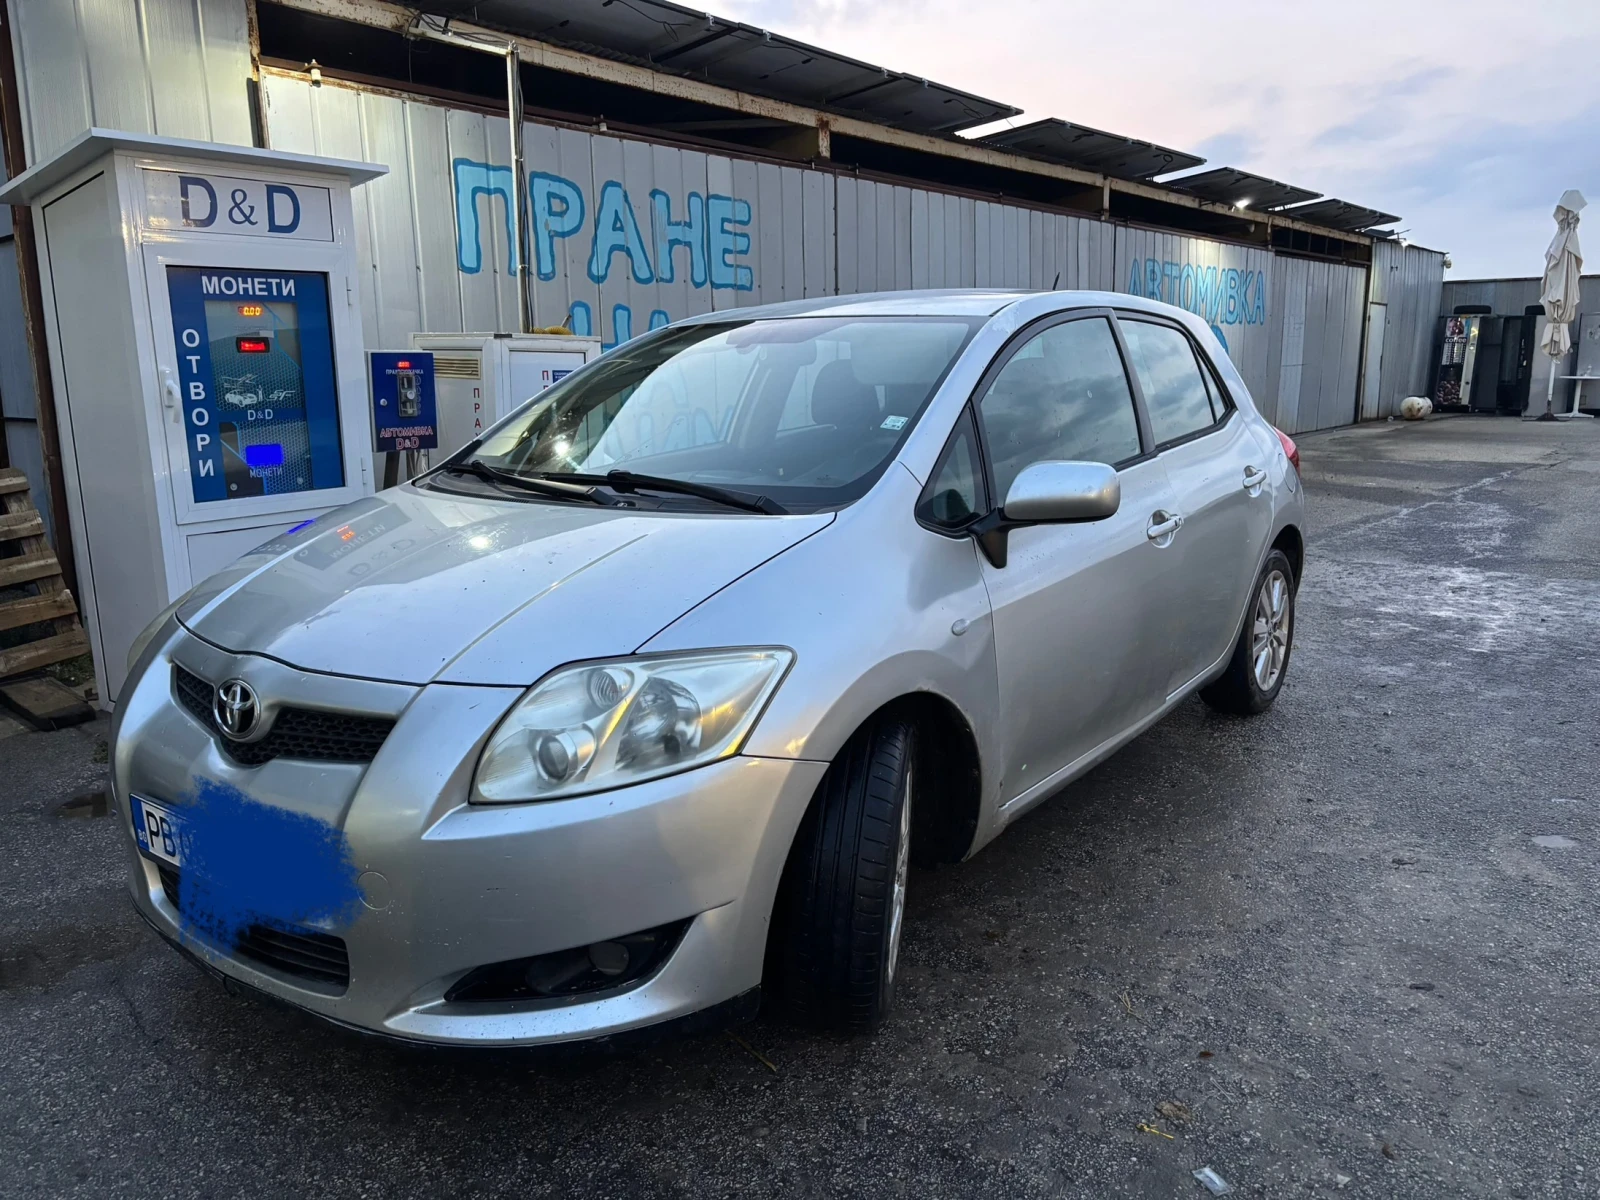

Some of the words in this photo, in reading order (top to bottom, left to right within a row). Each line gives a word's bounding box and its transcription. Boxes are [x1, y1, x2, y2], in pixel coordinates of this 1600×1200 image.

[453, 157, 753, 291] ПРАНЕ
[201, 275, 296, 297] МОНЕТИ
[1129, 258, 1265, 326] АВТОМИВКА
[181, 328, 215, 478] ОТВОРИ
[247, 409, 274, 421] D&D
[380, 425, 434, 438] АВТОМИВКА
[395, 436, 420, 450] D&D
